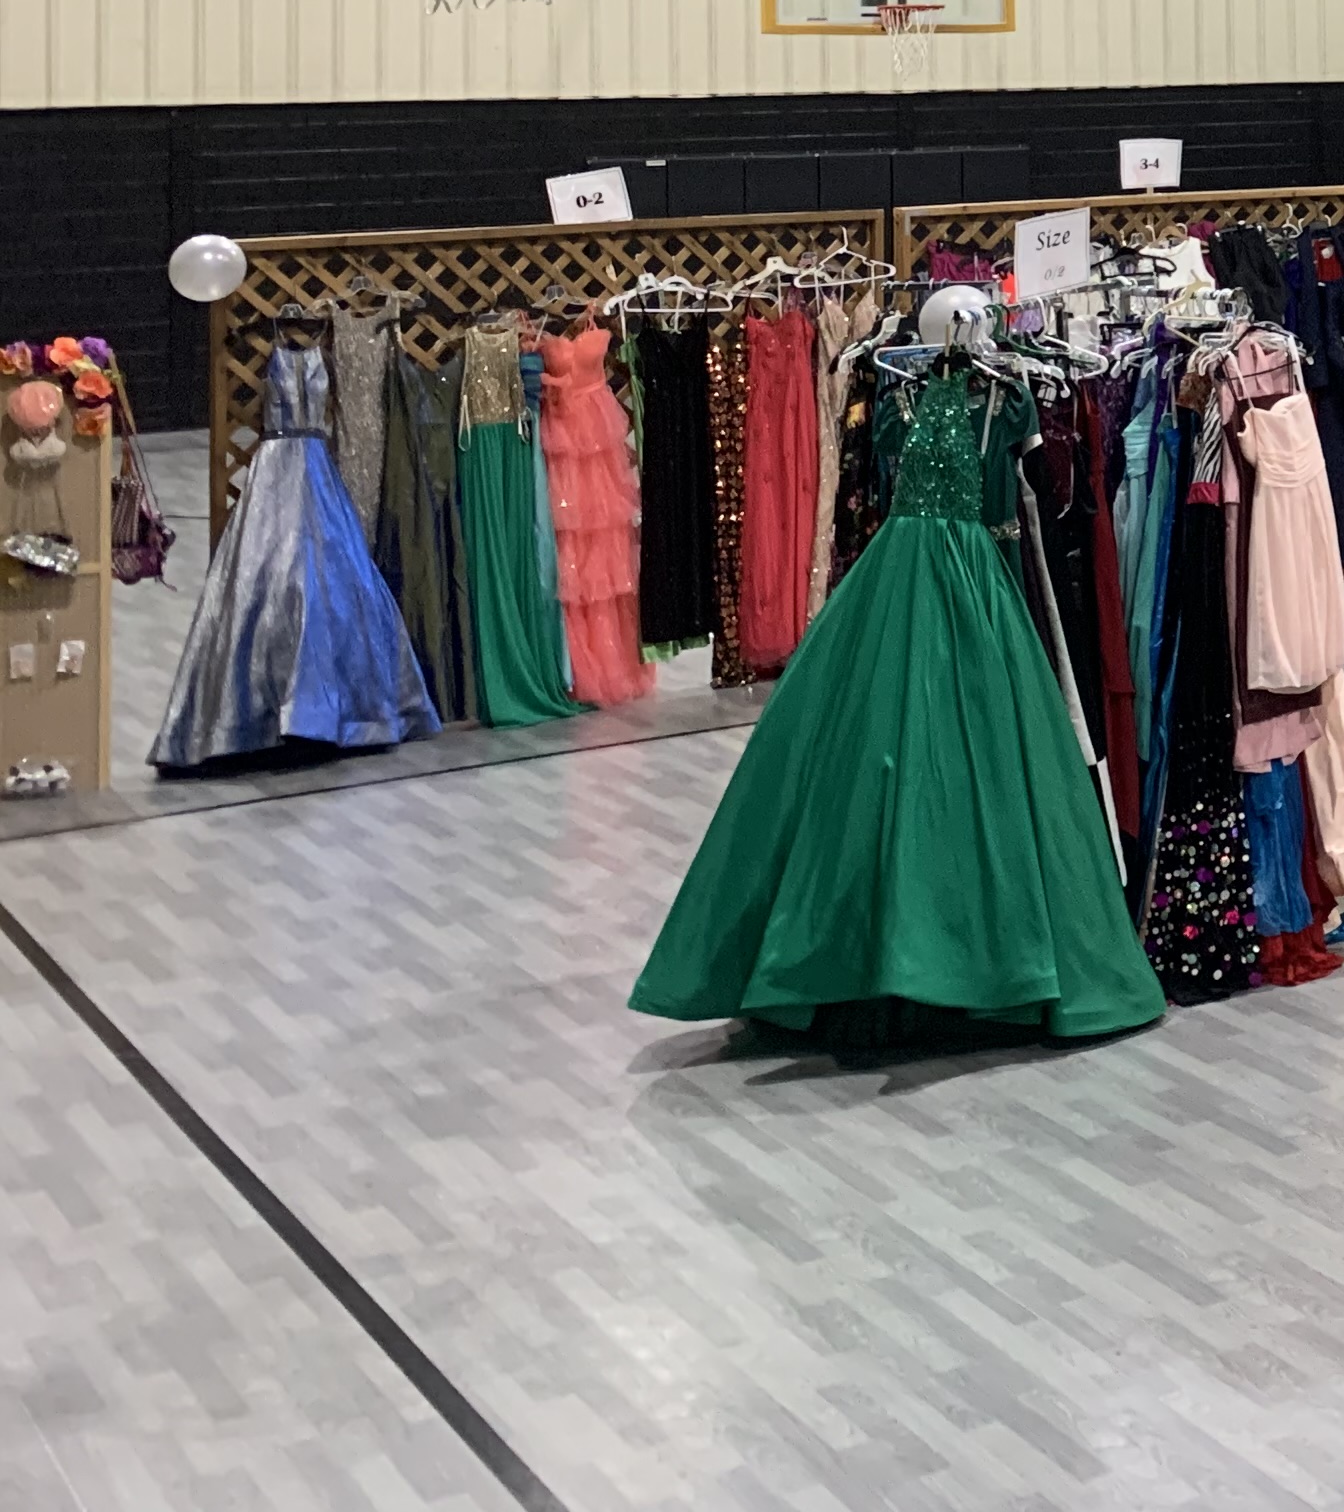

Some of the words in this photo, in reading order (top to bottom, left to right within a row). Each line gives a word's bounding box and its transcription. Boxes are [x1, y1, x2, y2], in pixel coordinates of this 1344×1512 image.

[1139, 158, 1160, 170] 3-4
[576, 191, 605, 208] 0-2
[1035, 229, 1072, 251] Size
